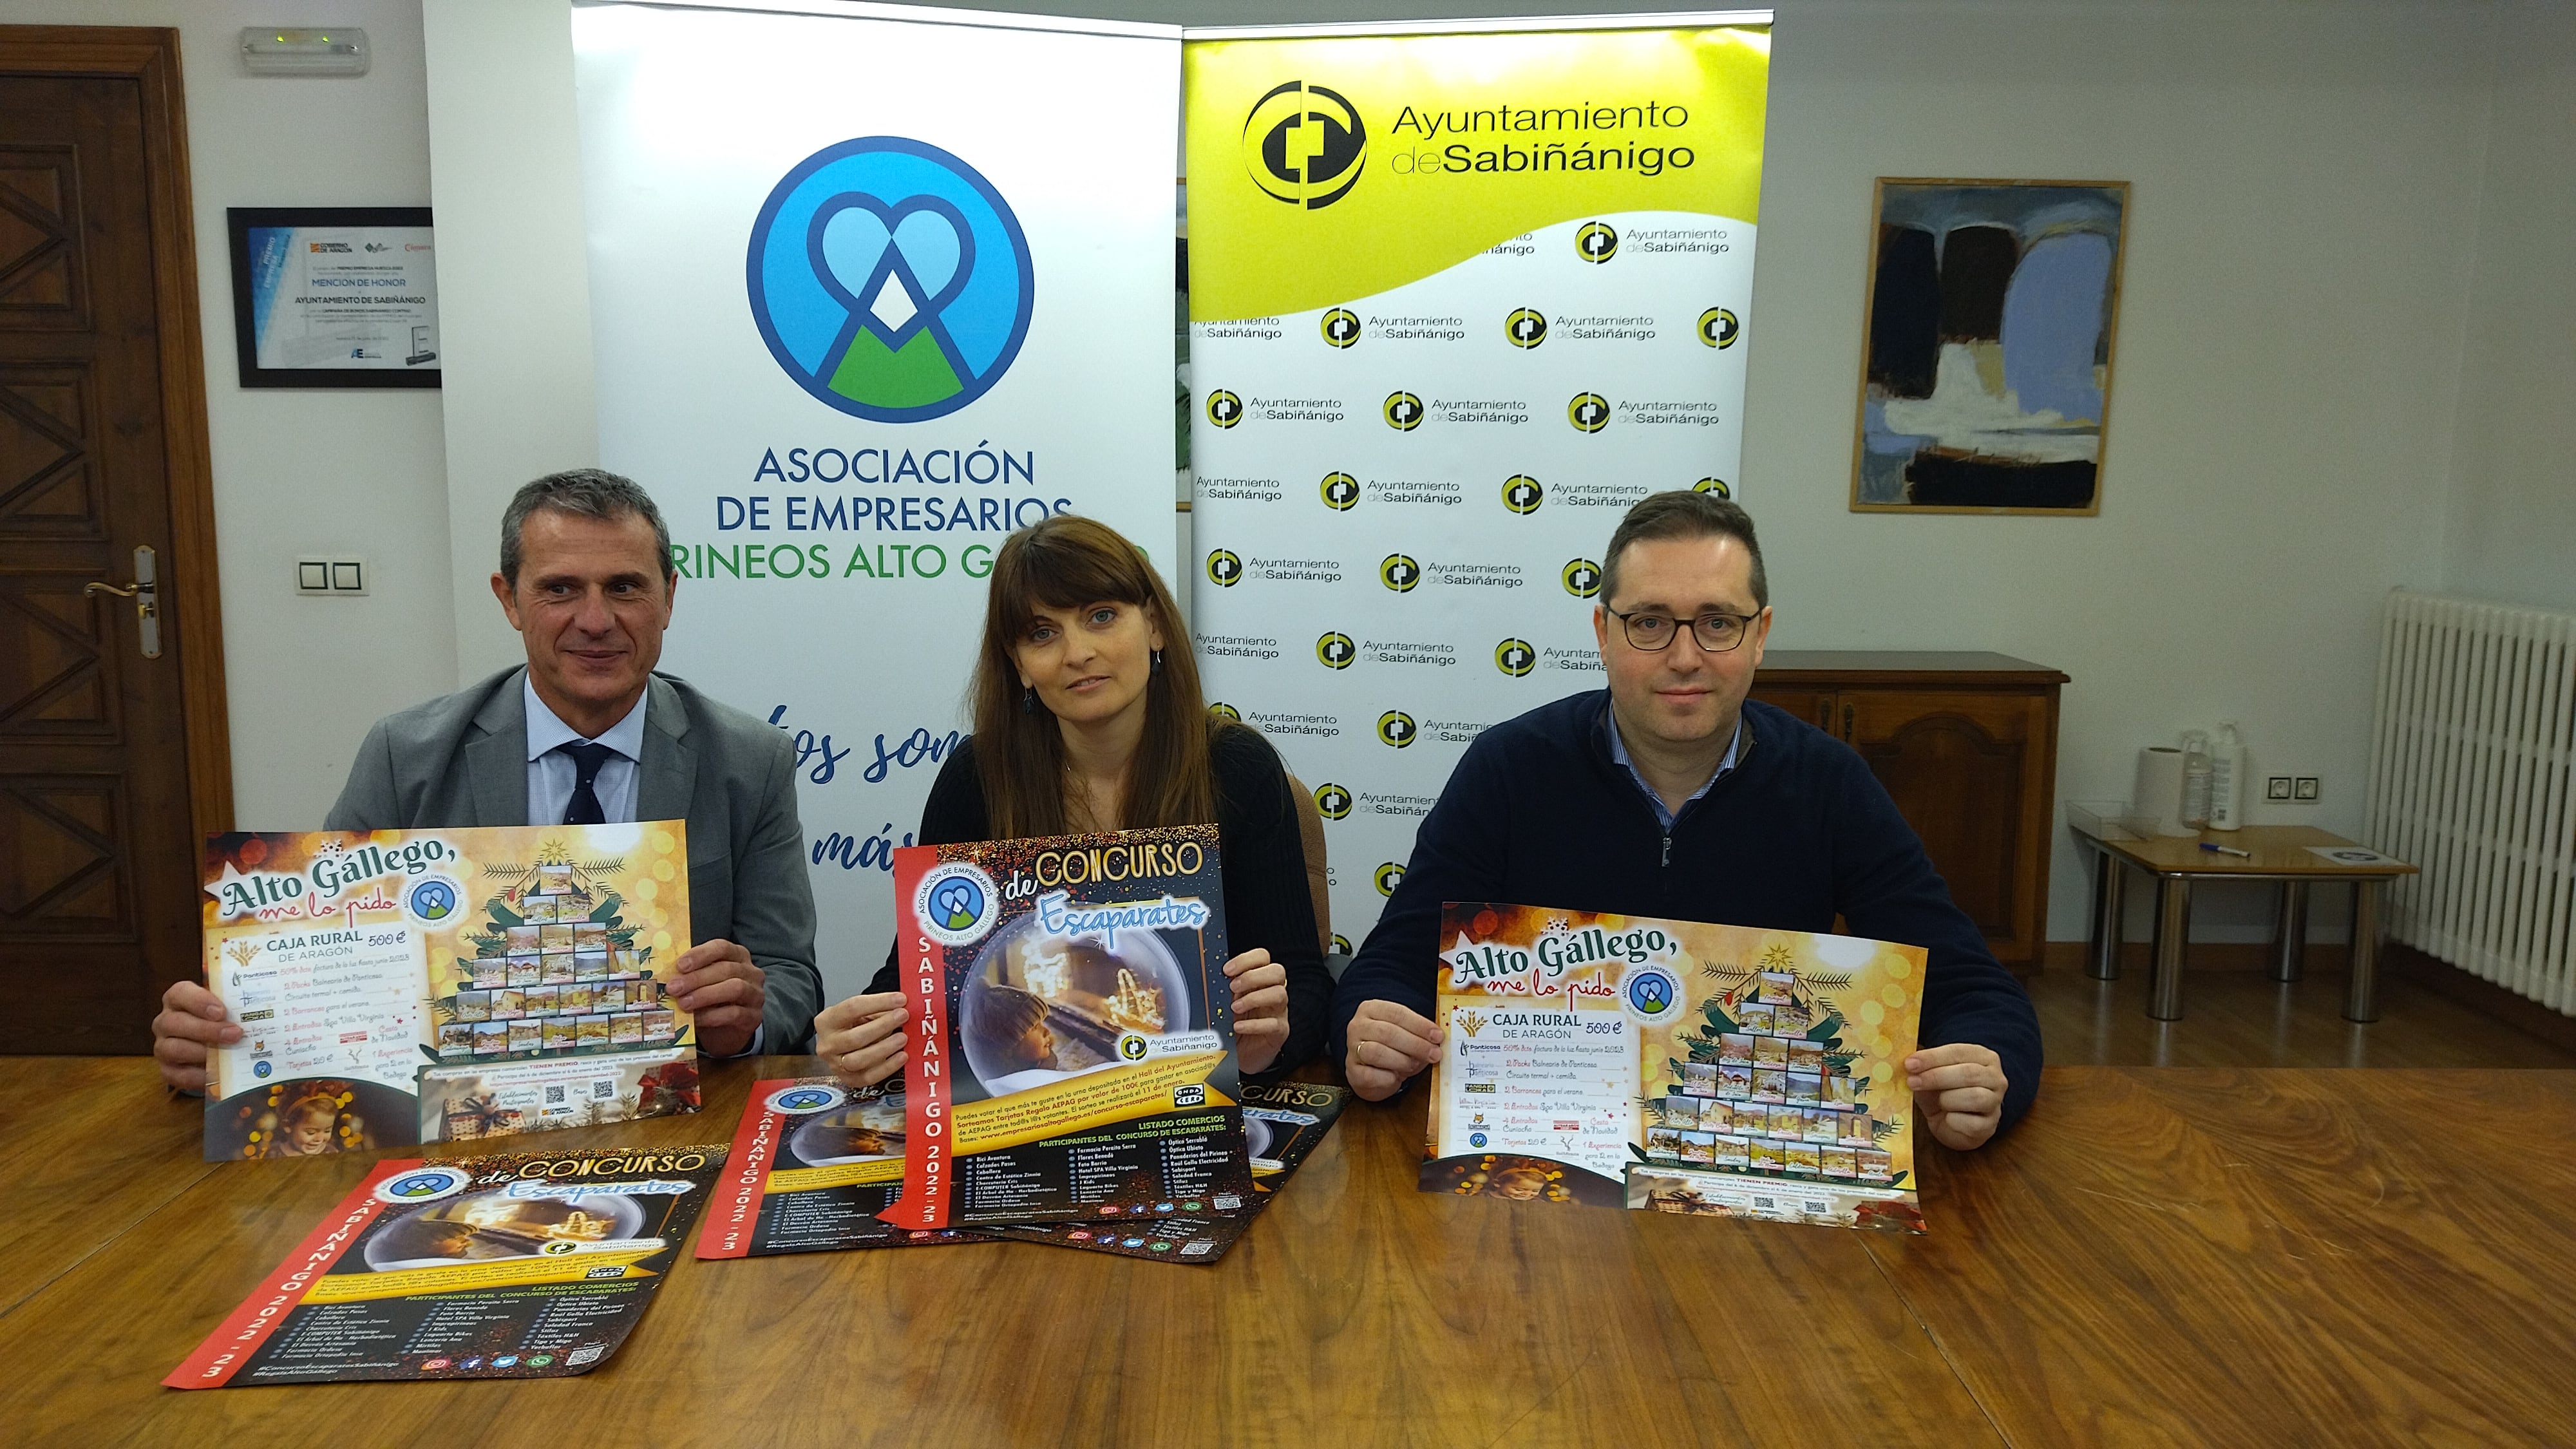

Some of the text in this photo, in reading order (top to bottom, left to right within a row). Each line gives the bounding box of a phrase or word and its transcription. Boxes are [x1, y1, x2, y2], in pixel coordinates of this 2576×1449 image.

[1391, 100, 1689, 140] Ayuntamiento
[1626, 227, 1727, 242] Ayuntamiento
[371, 279, 406, 287] HONOR
[1368, 315, 1463, 328] Ayuntamiento
[1555, 314, 1654, 328] Ayuntamiento
[1249, 397, 1342, 410] Ayuntamiento
[1431, 399, 1526, 412] Ayuntamiento
[1618, 399, 1718, 413] Ayuntamiento
[754, 439, 1034, 486] ASOCIACIÓN
[1196, 476, 1280, 489] Ayuntamiento
[1367, 479, 1460, 493] Ayuntamiento
[1550, 482, 1648, 497] Ayuntamiento
[717, 497, 770, 531] DE
[670, 544, 829, 580] RINEOS
[844, 544, 947, 580] ALTO
[1249, 557, 1340, 571] Ayuntamiento
[1427, 562, 1521, 575] Ayuntamiento
[1195, 633, 1276, 647] Ayuntamiento
[1363, 640, 1454, 654] Ayuntamiento
[1249, 712, 1338, 725] Ayuntamiento
[222, 876, 302, 916] Alto
[312, 840, 456, 898] Gállego,
[1005, 841, 1204, 901] de CONCURSO
[918, 867, 993, 914] ASOCIACIÓN DE EMPRESARIOS
[259, 905, 300, 920] me
[308, 891, 336, 918] lo
[346, 886, 397, 929] pido
[1040, 891, 1206, 949] Escaparates
[267, 930, 406, 952] CAJA RURAL 500 €
[923, 921, 954, 941] PIRINEOS
[956, 932, 974, 941] ALTO
[278, 946, 353, 963] DE ARAGÓN
[1454, 929, 1677, 984] Alto Gállego,
[1487, 968, 1616, 1012] me lo pido
[1492, 1014, 1622, 1035] CAJA RURAL 500 €
[1502, 1028, 1571, 1039] DE ARAGÓN
[918, 937, 942, 1137] SABIÑÁNIGO
[1150, 1034, 1215, 1048] Ayuntamiento
[1018, 1102, 1030, 1110] más
[1039, 1097, 1056, 1106] guste
[1139, 1069, 1152, 1079] Hall
[1154, 1066, 1164, 1075] del
[1166, 1054, 1216, 1072] Ayuntamiento.
[957, 1119, 994, 1128] Sorteamos
[996, 1112, 1024, 1123] Tarjetas
[1026, 1104, 1050, 1116] Regalo
[1052, 1098, 1075, 1110] AEPAG
[1077, 1095, 1089, 1104] por
[1091, 1090, 1109, 1099] valor
[1122, 1082, 1139, 1091] 100€
[1140, 1079, 1154, 1088] para
[1156, 1074, 1173, 1084] gastar
[1241, 1084, 1333, 1107] CURSO
[1138, 1115, 1226, 1130] LISTADO COMERCIOS
[1039, 1136, 1097, 1148] PARTICIPANTES
[1115, 1131, 1159, 1141] CONCURSO
[1172, 1124, 1226, 1135] ESCAPARATES:
[478, 1154, 705, 1185] de CONCURSO
[507, 1180, 688, 1204] Escaparates
[531, 1281, 639, 1292] LISTADO COMERCIOS
